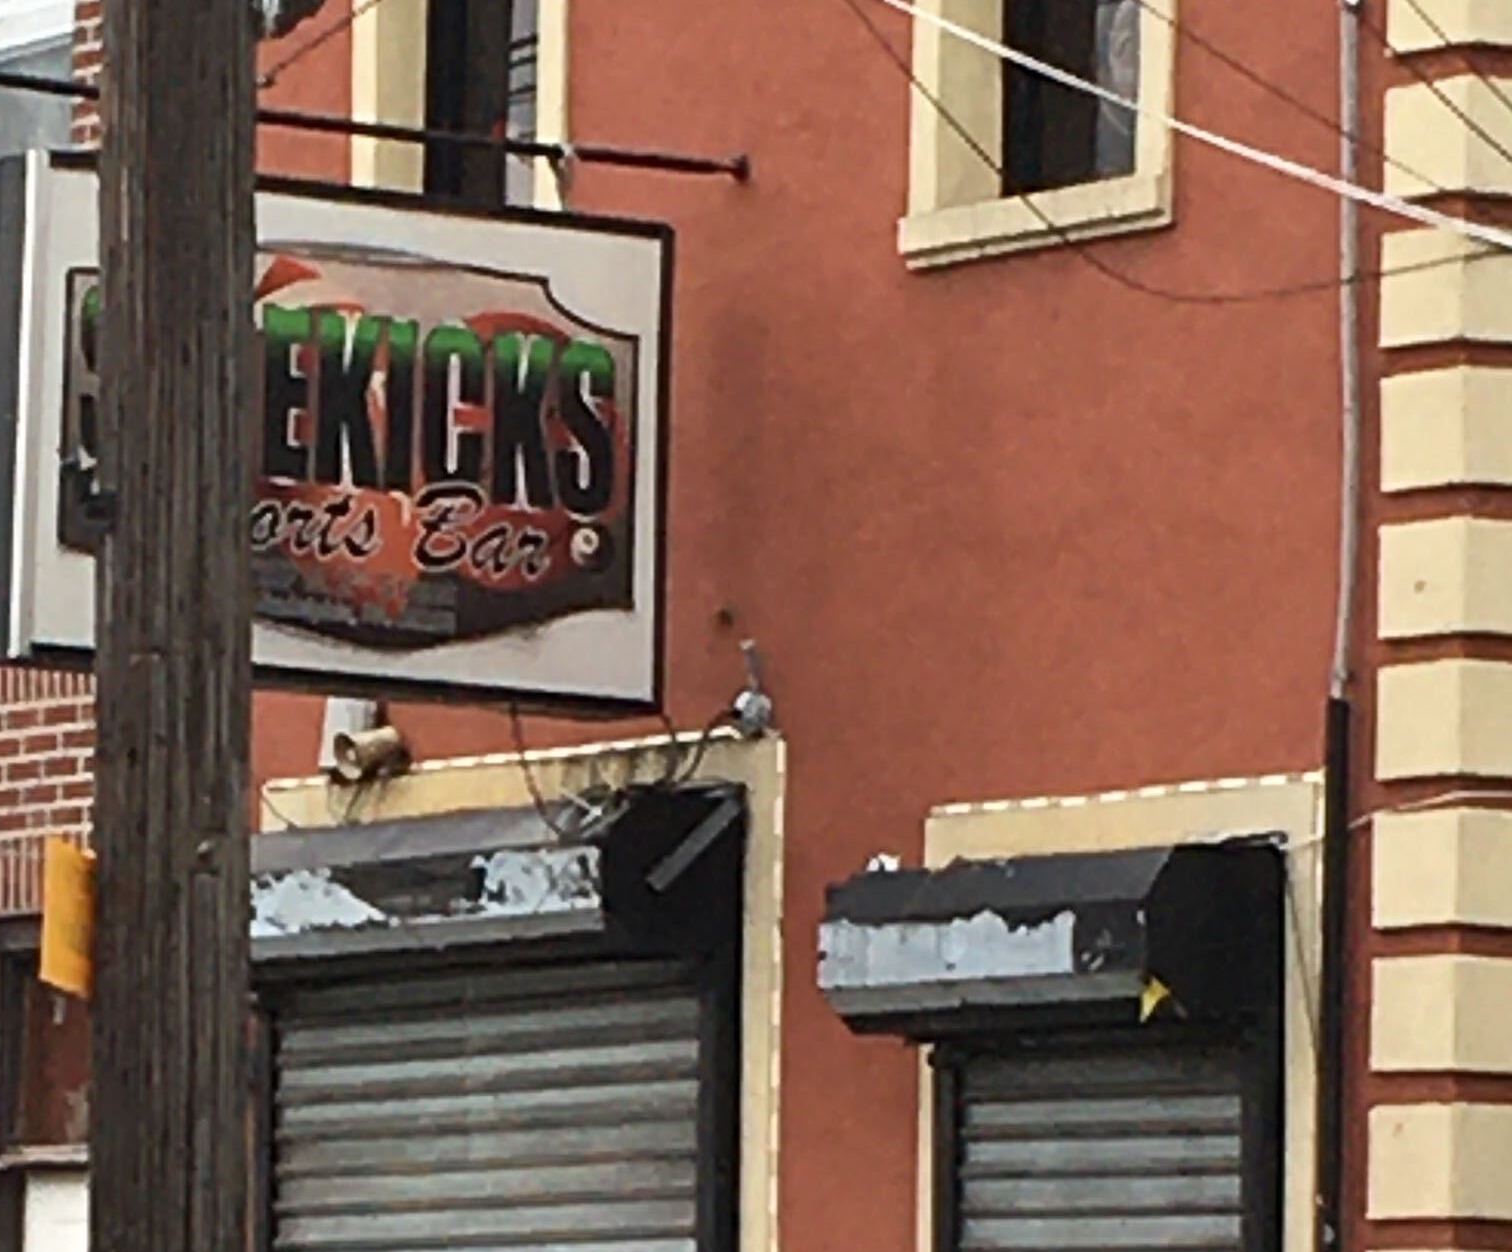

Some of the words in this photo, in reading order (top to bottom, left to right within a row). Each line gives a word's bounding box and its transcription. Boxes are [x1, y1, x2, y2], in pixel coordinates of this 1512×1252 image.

[82, 286, 617, 519] EKICKS
[250, 493, 382, 562] orts
[412, 481, 550, 581] Bar
